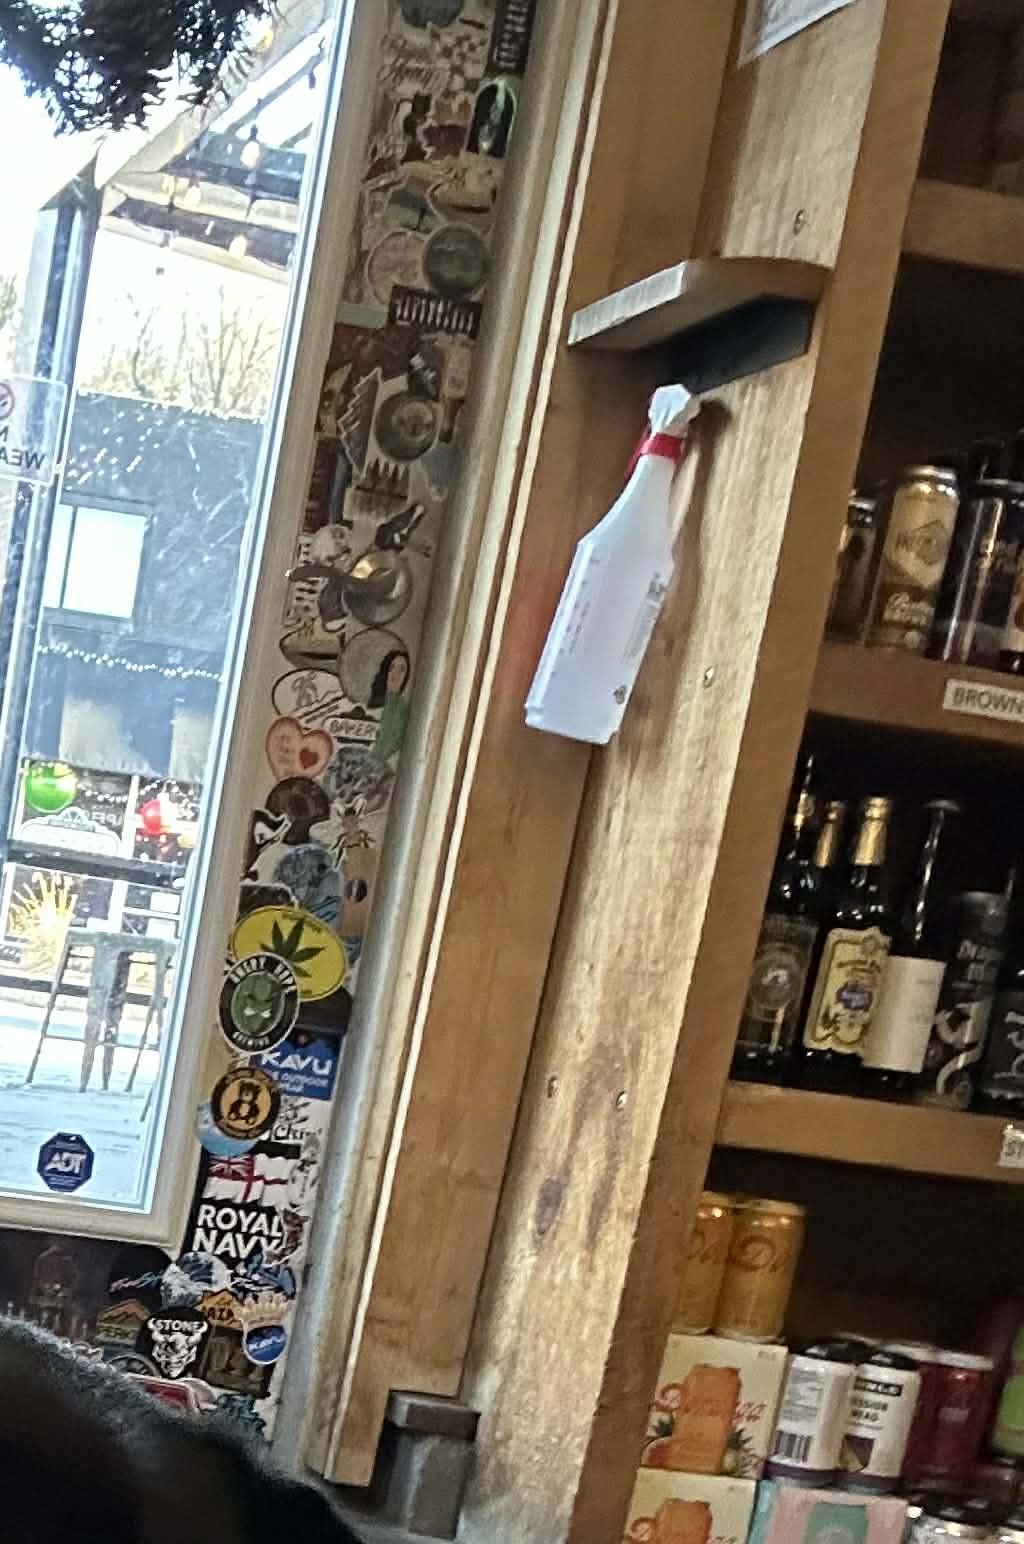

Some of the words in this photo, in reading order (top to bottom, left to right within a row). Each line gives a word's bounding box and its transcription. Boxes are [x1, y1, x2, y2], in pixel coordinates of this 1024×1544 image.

[45, 1150, 88, 1176] ADT
[197, 1204, 284, 1238] ROYAL
[192, 1228, 283, 1259] NAVY
[154, 1318, 204, 1333] STONE
